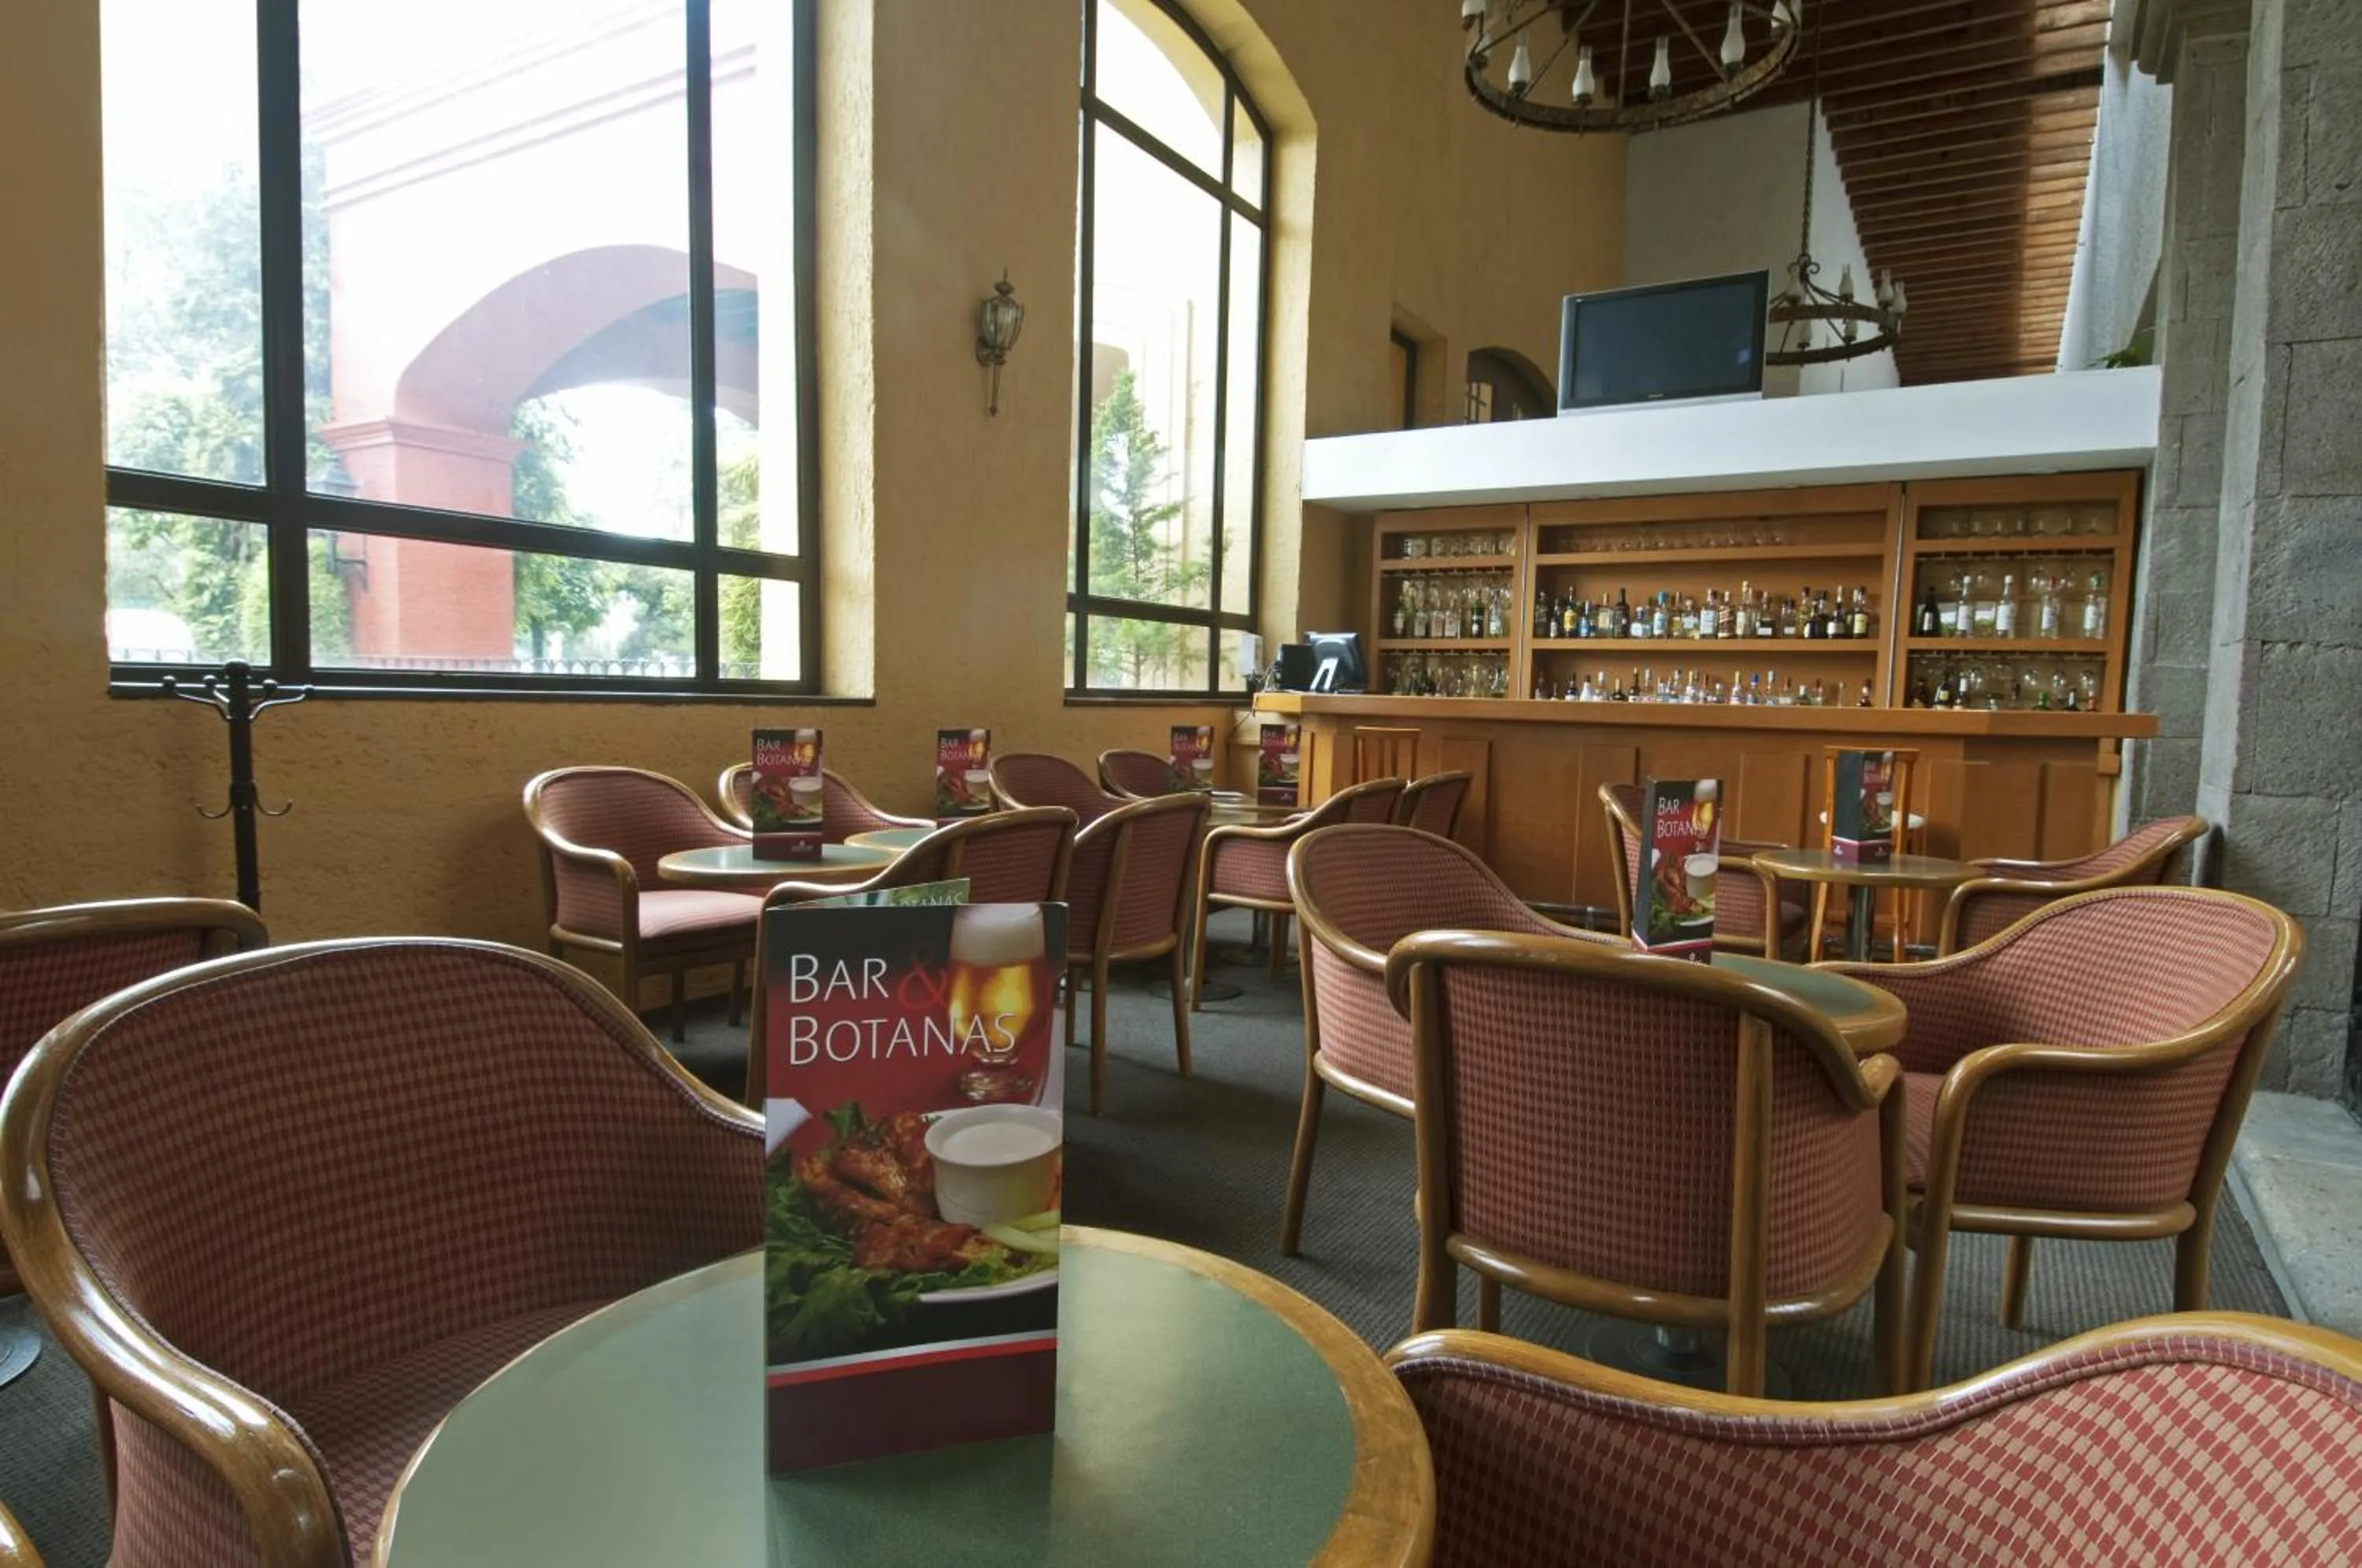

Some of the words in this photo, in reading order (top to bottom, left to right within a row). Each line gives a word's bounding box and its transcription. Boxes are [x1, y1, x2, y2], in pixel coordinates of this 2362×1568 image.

[757, 738, 781, 752] BAR
[1657, 797, 1679, 816] BAR
[790, 954, 889, 1004] BAR
[790, 1011, 1016, 1066] BOTANAS
